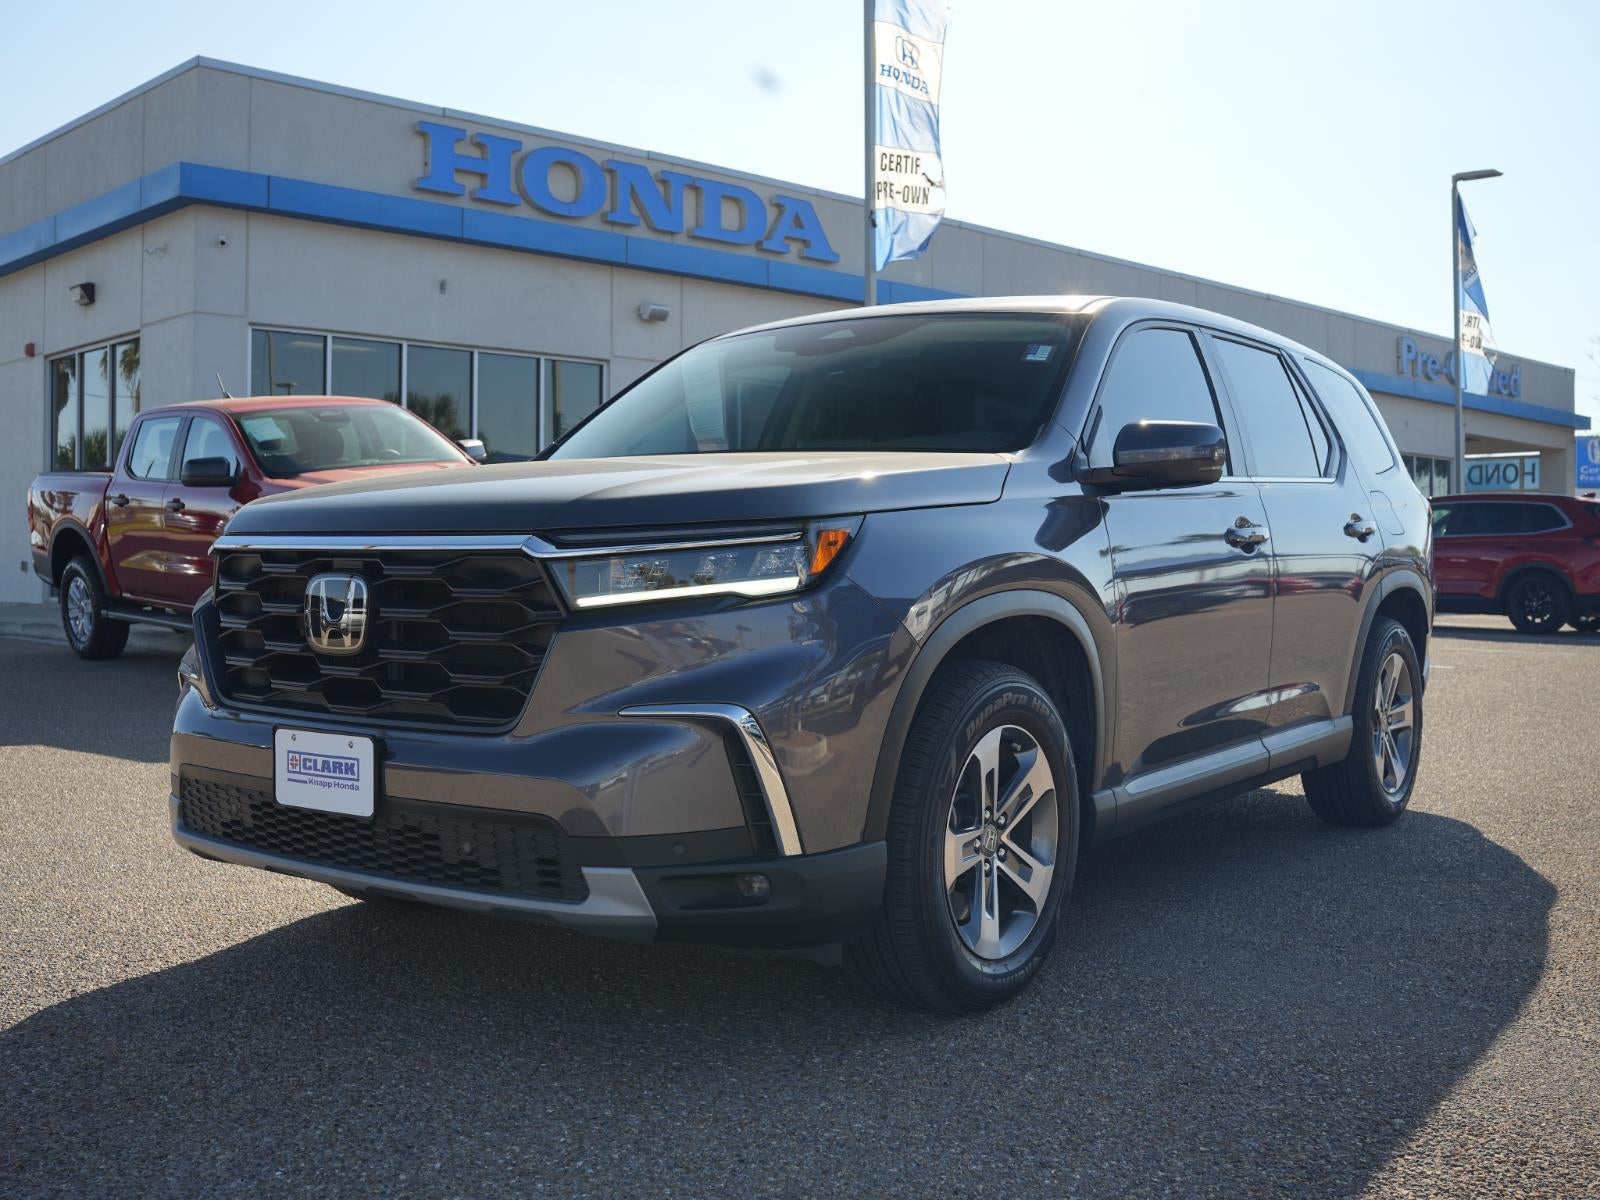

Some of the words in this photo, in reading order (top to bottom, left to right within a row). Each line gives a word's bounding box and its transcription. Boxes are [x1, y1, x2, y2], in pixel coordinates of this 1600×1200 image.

[880, 63, 930, 95] HONDA
[413, 120, 841, 263] HONDA
[302, 757, 357, 777] CLARK
[308, 777, 333, 789] Knapp
[333, 781, 360, 791] Honda
